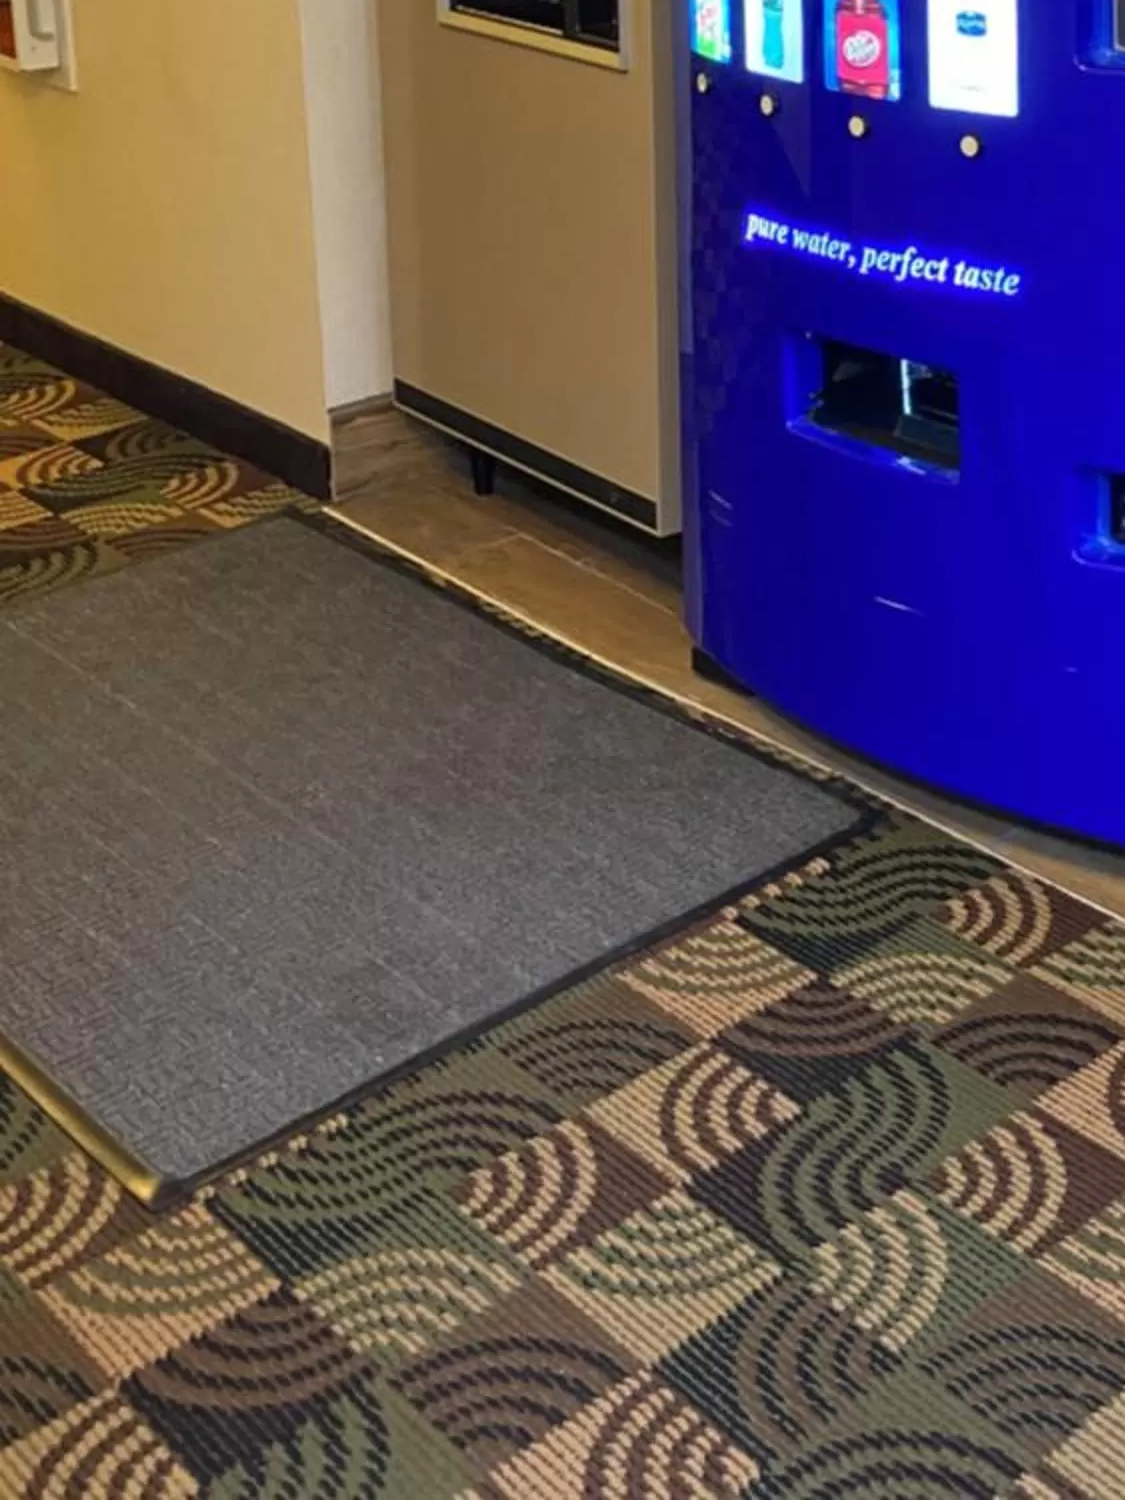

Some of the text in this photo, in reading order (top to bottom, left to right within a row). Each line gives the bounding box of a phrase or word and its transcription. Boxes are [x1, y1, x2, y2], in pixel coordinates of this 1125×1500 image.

[745, 213, 1021, 296] pure water, perfect taste
